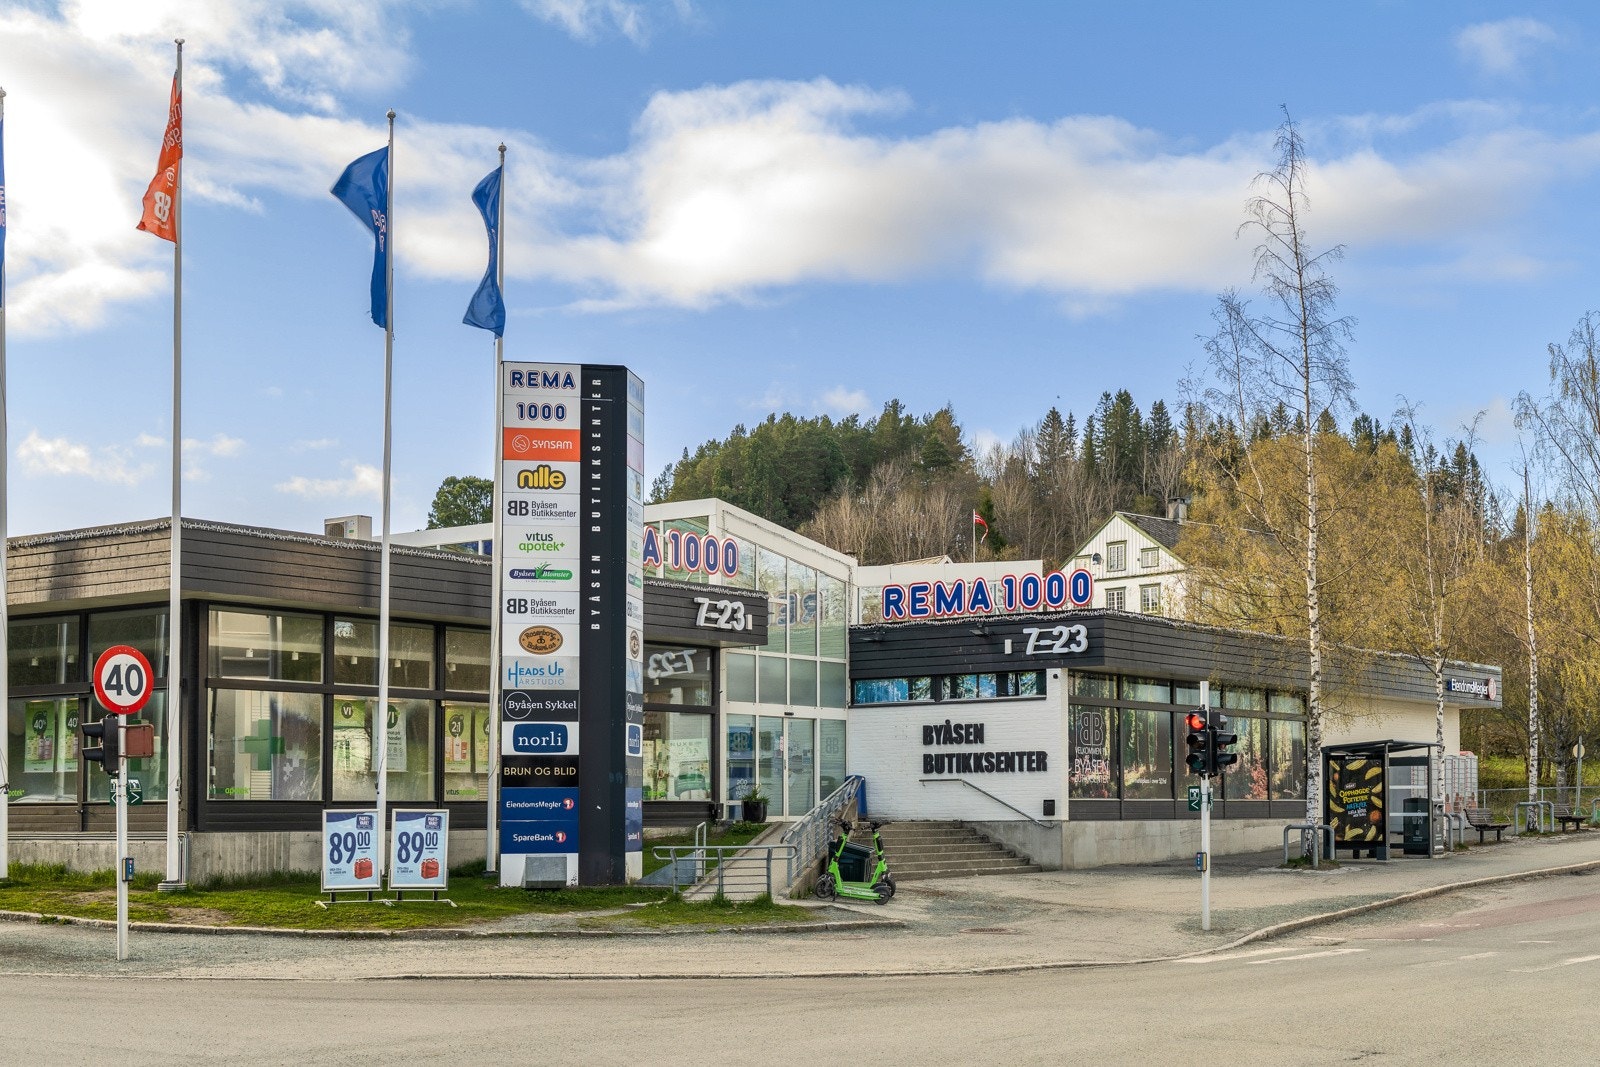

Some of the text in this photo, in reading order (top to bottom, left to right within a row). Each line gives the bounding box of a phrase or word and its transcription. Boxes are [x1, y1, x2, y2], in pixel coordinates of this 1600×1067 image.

[510, 370, 576, 389] REMA
[516, 402, 566, 421] 1000
[532, 440, 573, 449] SYNSAM
[517, 464, 566, 490] nille
[531, 501, 557, 510] Byåsen
[531, 509, 577, 518] Butikksenter
[589, 378, 602, 630] BYÅSEN BUTIKKSENTER
[526, 532, 553, 541] vitus
[665, 527, 739, 578] 1000
[530, 598, 557, 607] Byåsen
[882, 568, 1092, 620] REMA 1000
[530, 607, 576, 615] Butikksenter
[694, 596, 745, 631] 7-23
[1023, 624, 1088, 655] 7-23
[105, 664, 143, 696] 40
[508, 700, 577, 711] Byåsen Sykkel
[518, 731, 562, 746] norli
[922, 719, 984, 745] BYÅSEN
[504, 767, 576, 775] BRUN OG BLID
[922, 750, 1047, 774] BUTIKKSENTER
[506, 801, 561, 809] EiendomsMegler
[512, 833, 554, 842] SpareBank
[329, 831, 371, 864] 89 00
[397, 831, 438, 864] 89 00
